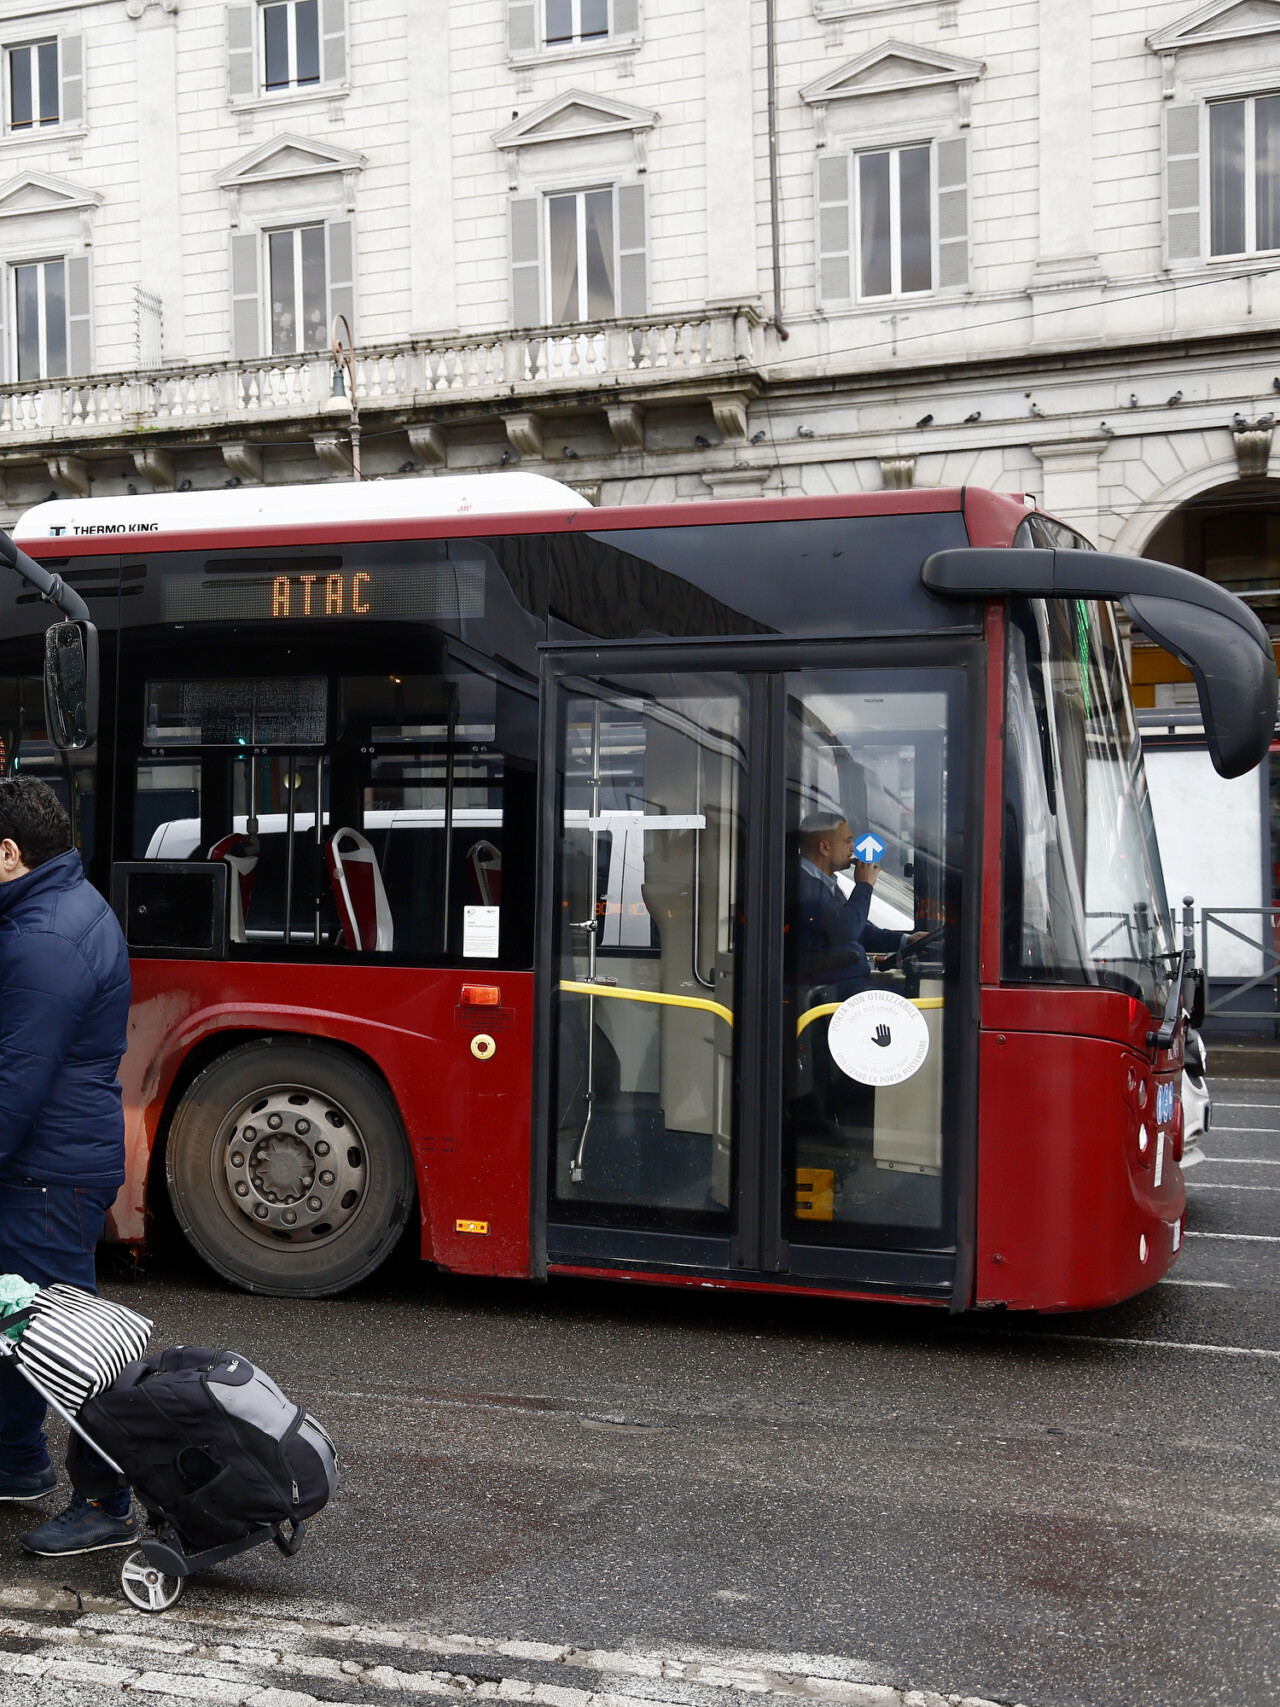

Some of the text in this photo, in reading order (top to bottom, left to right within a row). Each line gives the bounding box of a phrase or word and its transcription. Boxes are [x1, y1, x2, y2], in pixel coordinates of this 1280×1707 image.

[73, 523, 158, 535] THERMO KING
[273, 573, 370, 616] ATAC
[831, 992, 919, 1031] PORTA NON UTILIZZABILE
[836, 1052, 867, 1081] UTILIZZARE
[880, 1072, 903, 1083] PORTA
[902, 1040, 927, 1076] POSTERIORE
